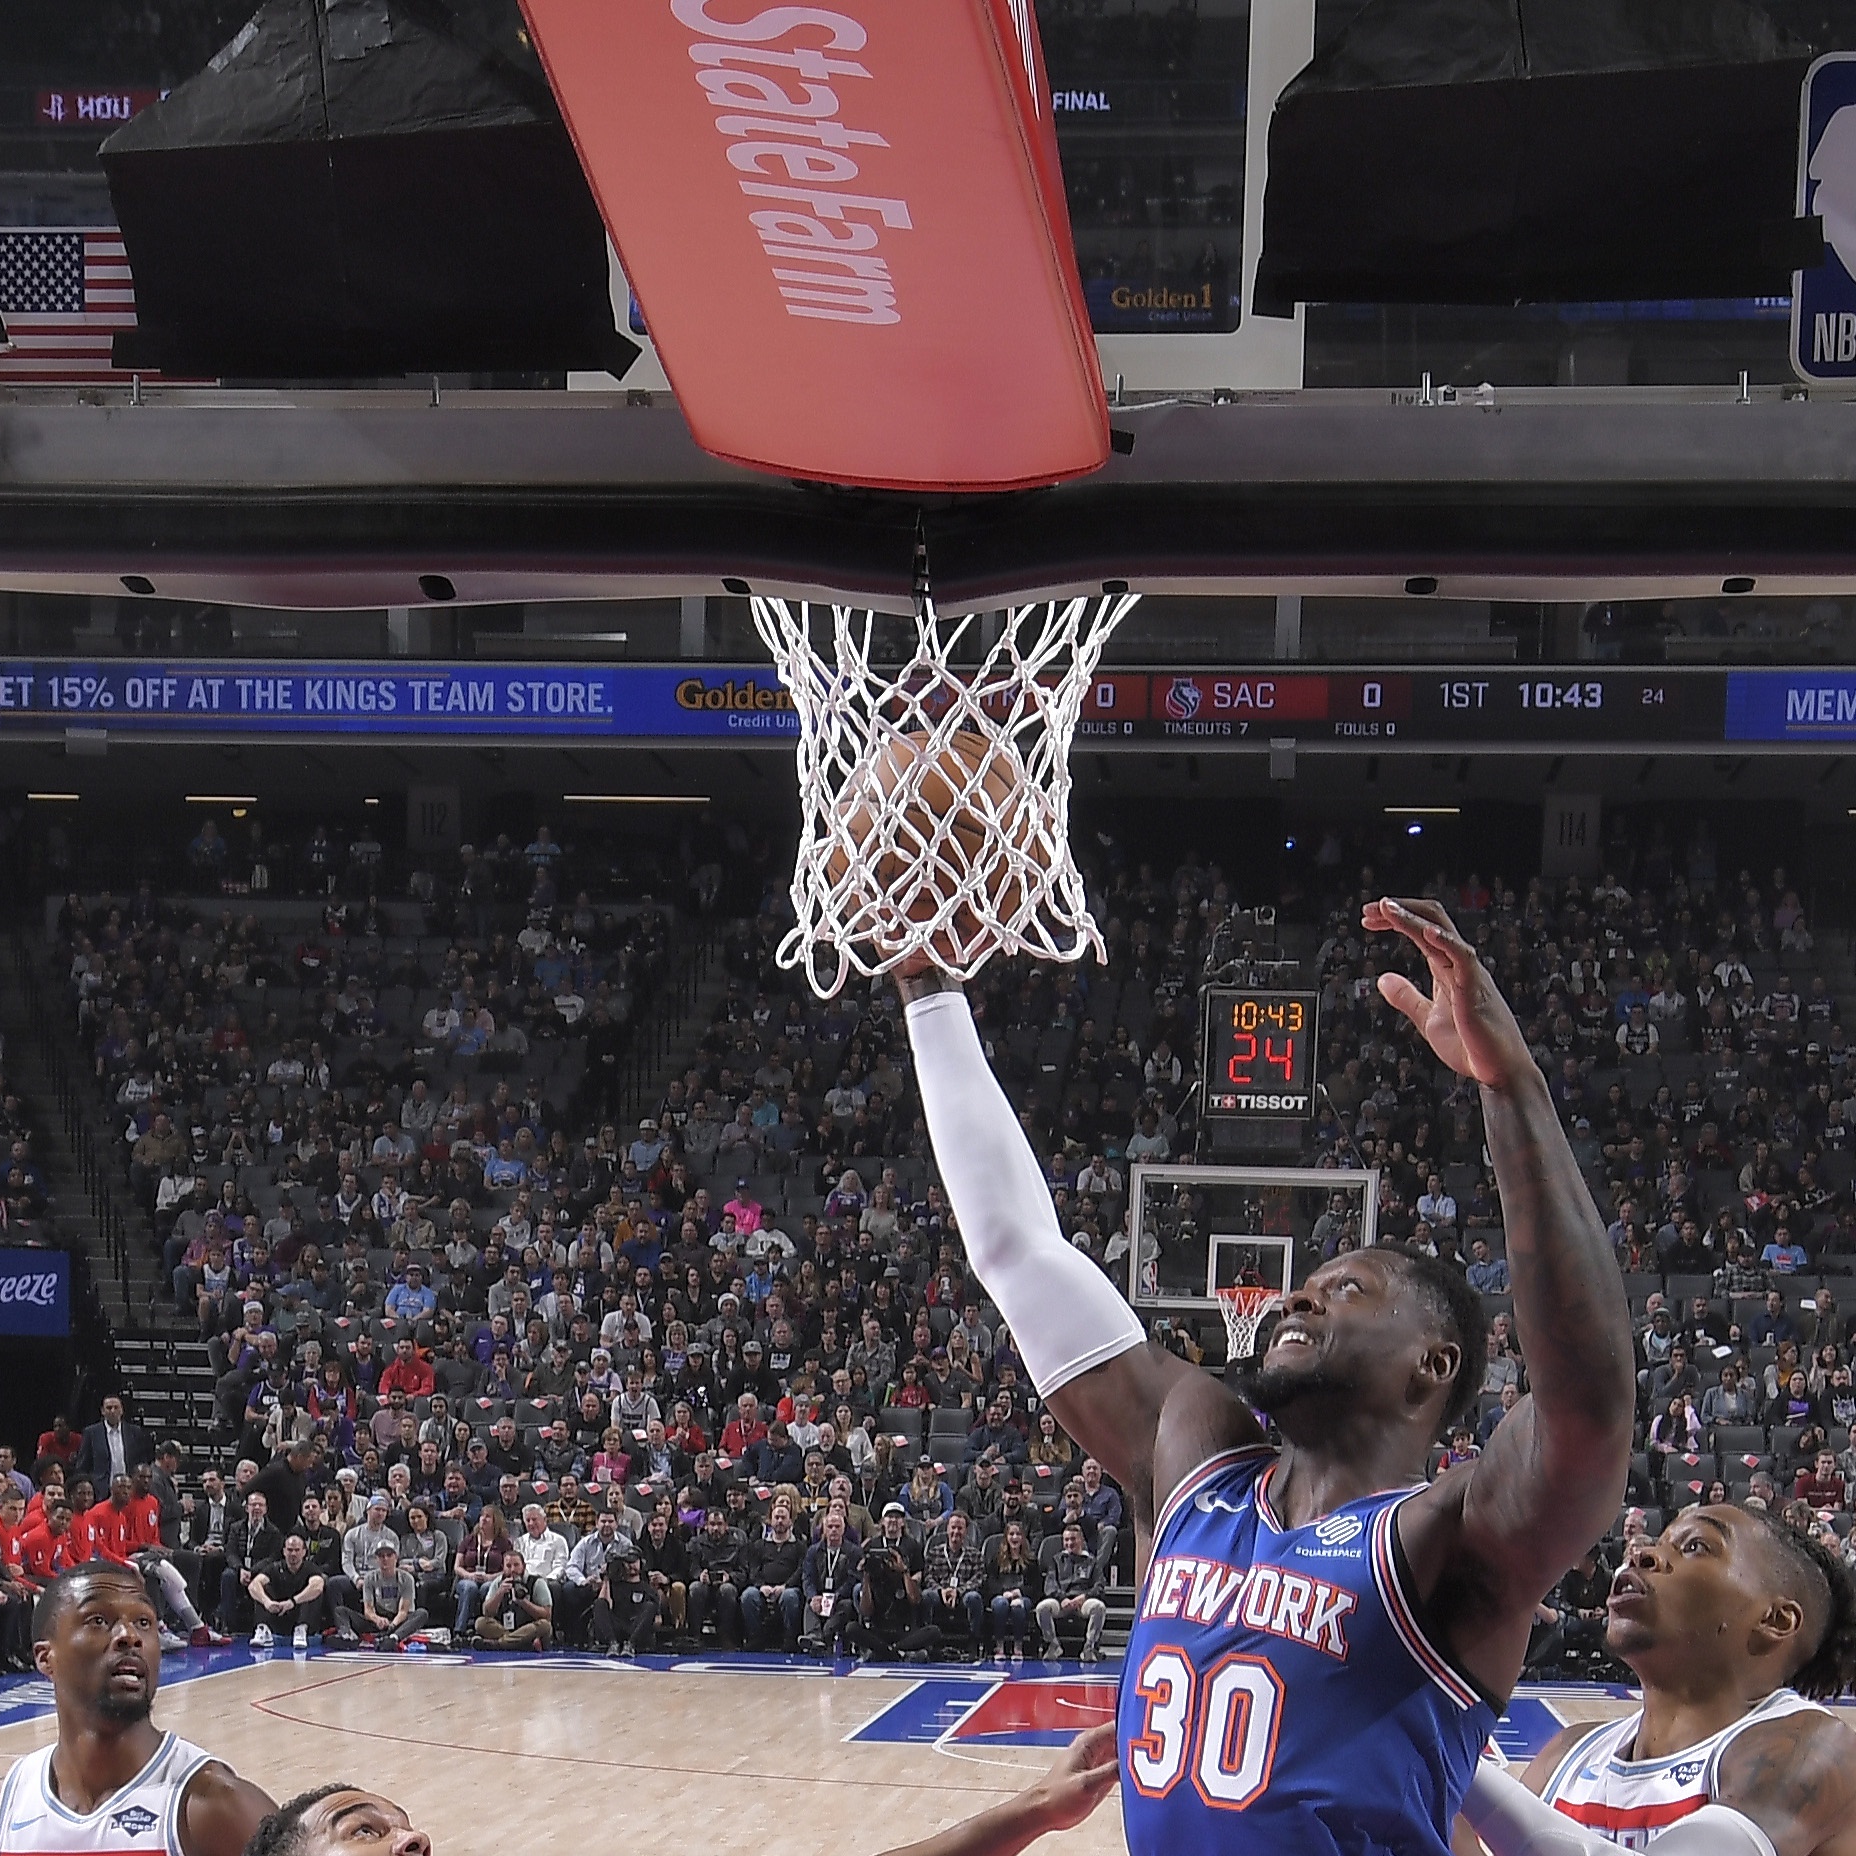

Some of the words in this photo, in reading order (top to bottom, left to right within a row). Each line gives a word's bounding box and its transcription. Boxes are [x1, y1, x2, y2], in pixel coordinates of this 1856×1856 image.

[1052, 91, 1111, 111] FINAL
[1110, 286, 1197, 309] Golden
[47, 675, 115, 709] 15%
[124, 677, 178, 710] OFF
[186, 678, 225, 710] AT
[234, 678, 293, 711] THE
[303, 679, 397, 712] KINGS
[408, 680, 495, 713] TEAM
[506, 681, 614, 714] STORE.
[675, 676, 796, 712] Golden
[1212, 682, 1276, 709] SAC
[1362, 682, 1382, 709] 0
[1439, 682, 1490, 709] 1ST
[1517, 682, 1604, 709] 10:43
[1641, 688, 1665, 704] 24
[727, 713, 781, 730] Credit
[1163, 721, 1232, 736] TIMEOUTS
[1239, 722, 1250, 736] 7
[1334, 721, 1380, 736] FOULS
[1385, 721, 1397, 736] 0
[1232, 1000, 1304, 1032] 10:43
[1227, 1032, 1294, 1084] 24
[1236, 1094, 1309, 1111] TISSOT
[1295, 1545, 1362, 1558] SQUARESPACE
[1127, 1645, 1286, 1812] 30
